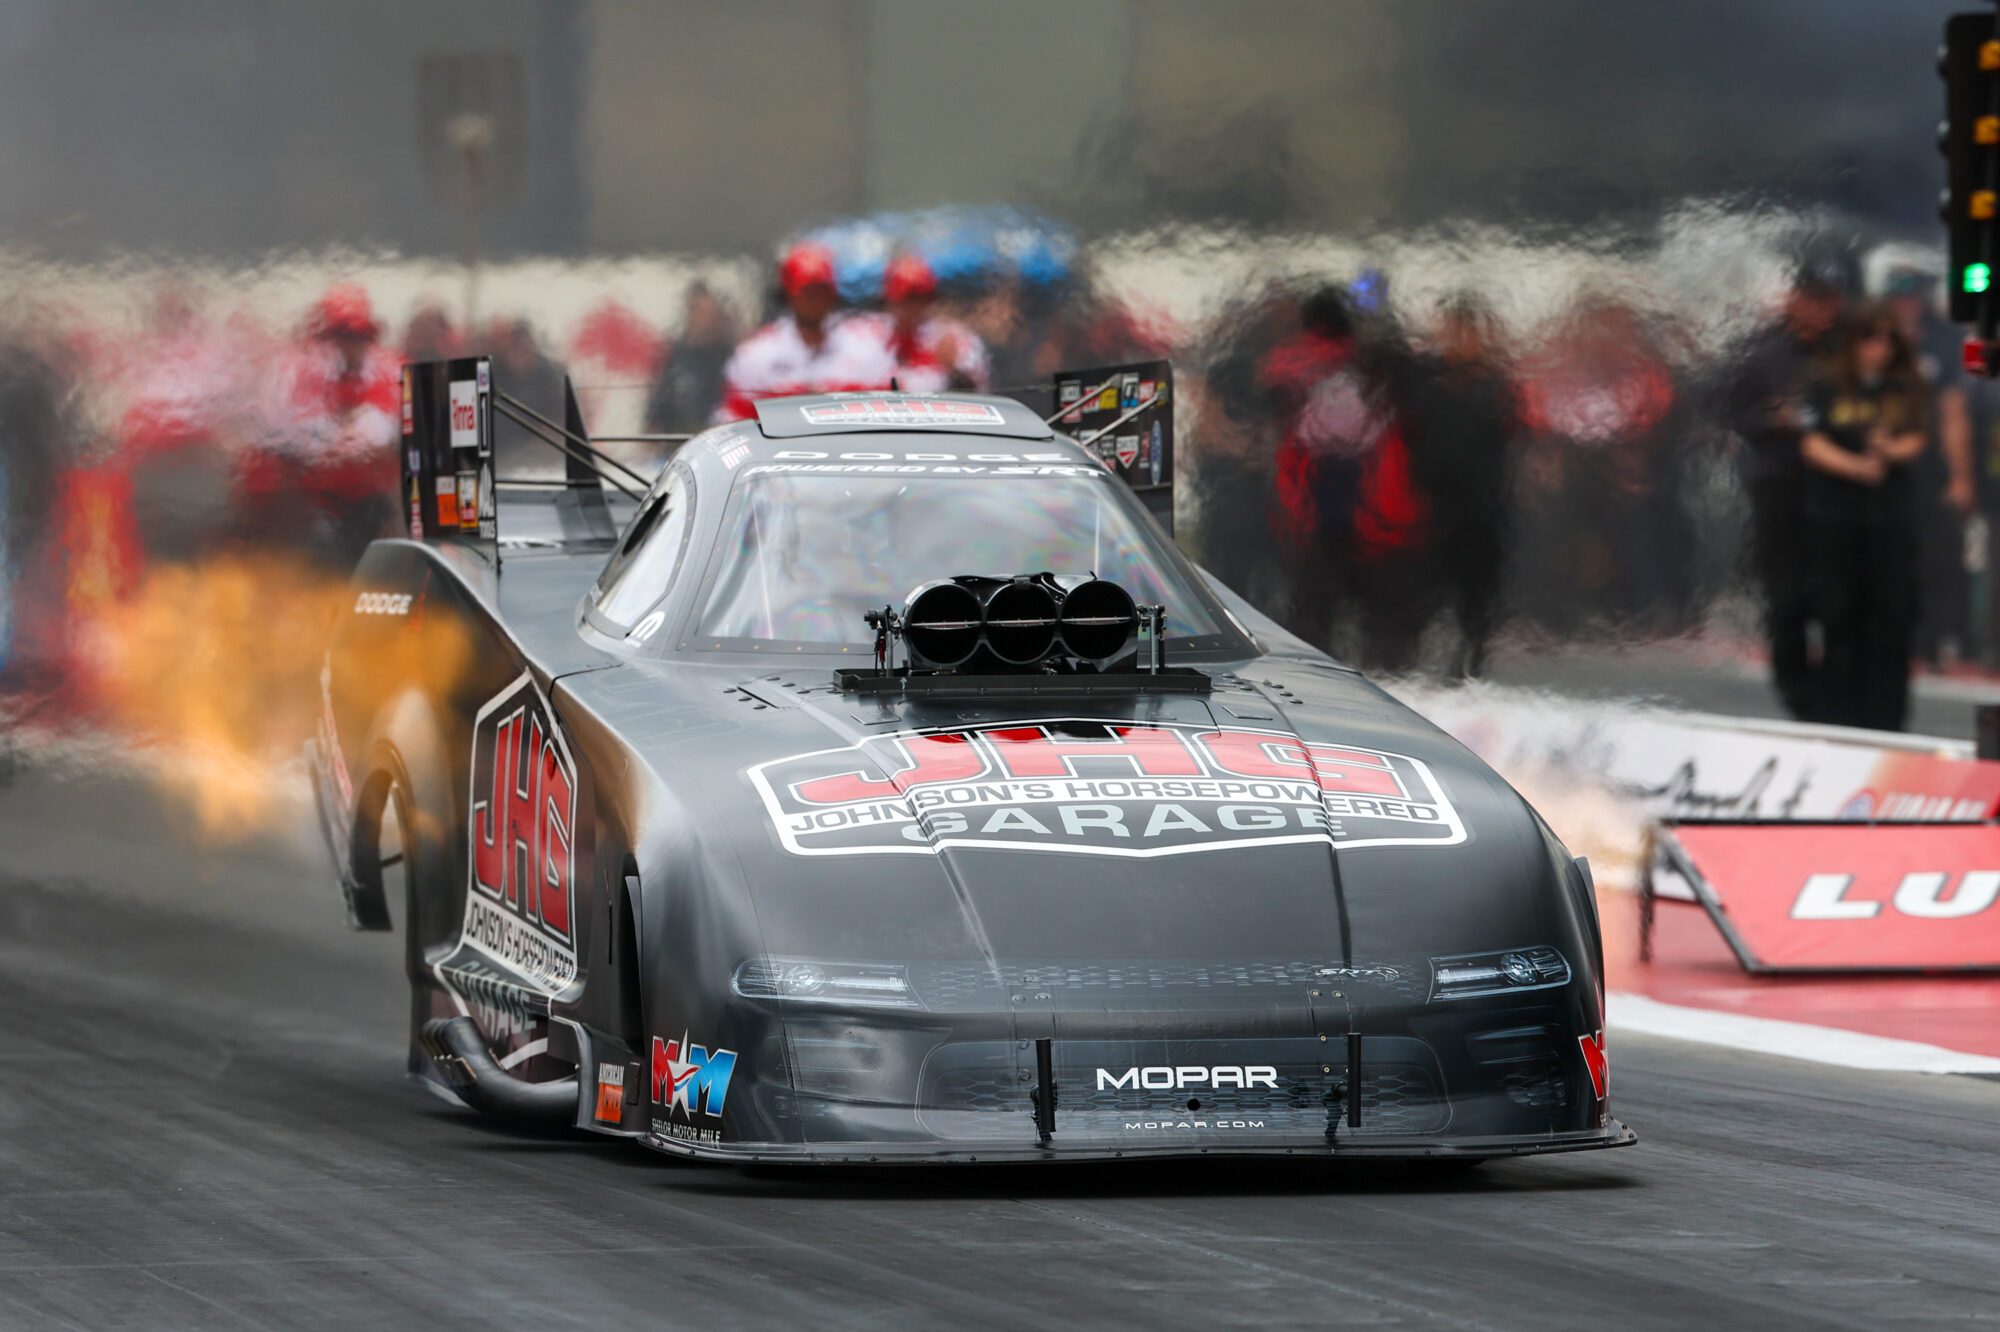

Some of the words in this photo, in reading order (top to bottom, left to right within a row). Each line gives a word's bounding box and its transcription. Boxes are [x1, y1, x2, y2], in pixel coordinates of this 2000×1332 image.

[773, 451, 1072, 462] DODGE
[743, 464, 927, 477] POWERED
[932, 466, 986, 474] BY
[989, 466, 1106, 477] SRT
[354, 592, 413, 615] DODGE
[788, 725, 1413, 806] JHG
[791, 781, 1054, 832] JOHNSON'S
[1068, 780, 1439, 821] HORSEPOWERED
[473, 704, 571, 947] JHG
[901, 804, 1347, 842] GARAGE
[1096, 1065, 1280, 1091] MOPAR
[651, 1117, 672, 1136] SHELOR
[672, 1124, 698, 1142] MOTOR
[699, 1129, 721, 1145] MILE
[1125, 1120, 1265, 1130] MOPAR.COM
